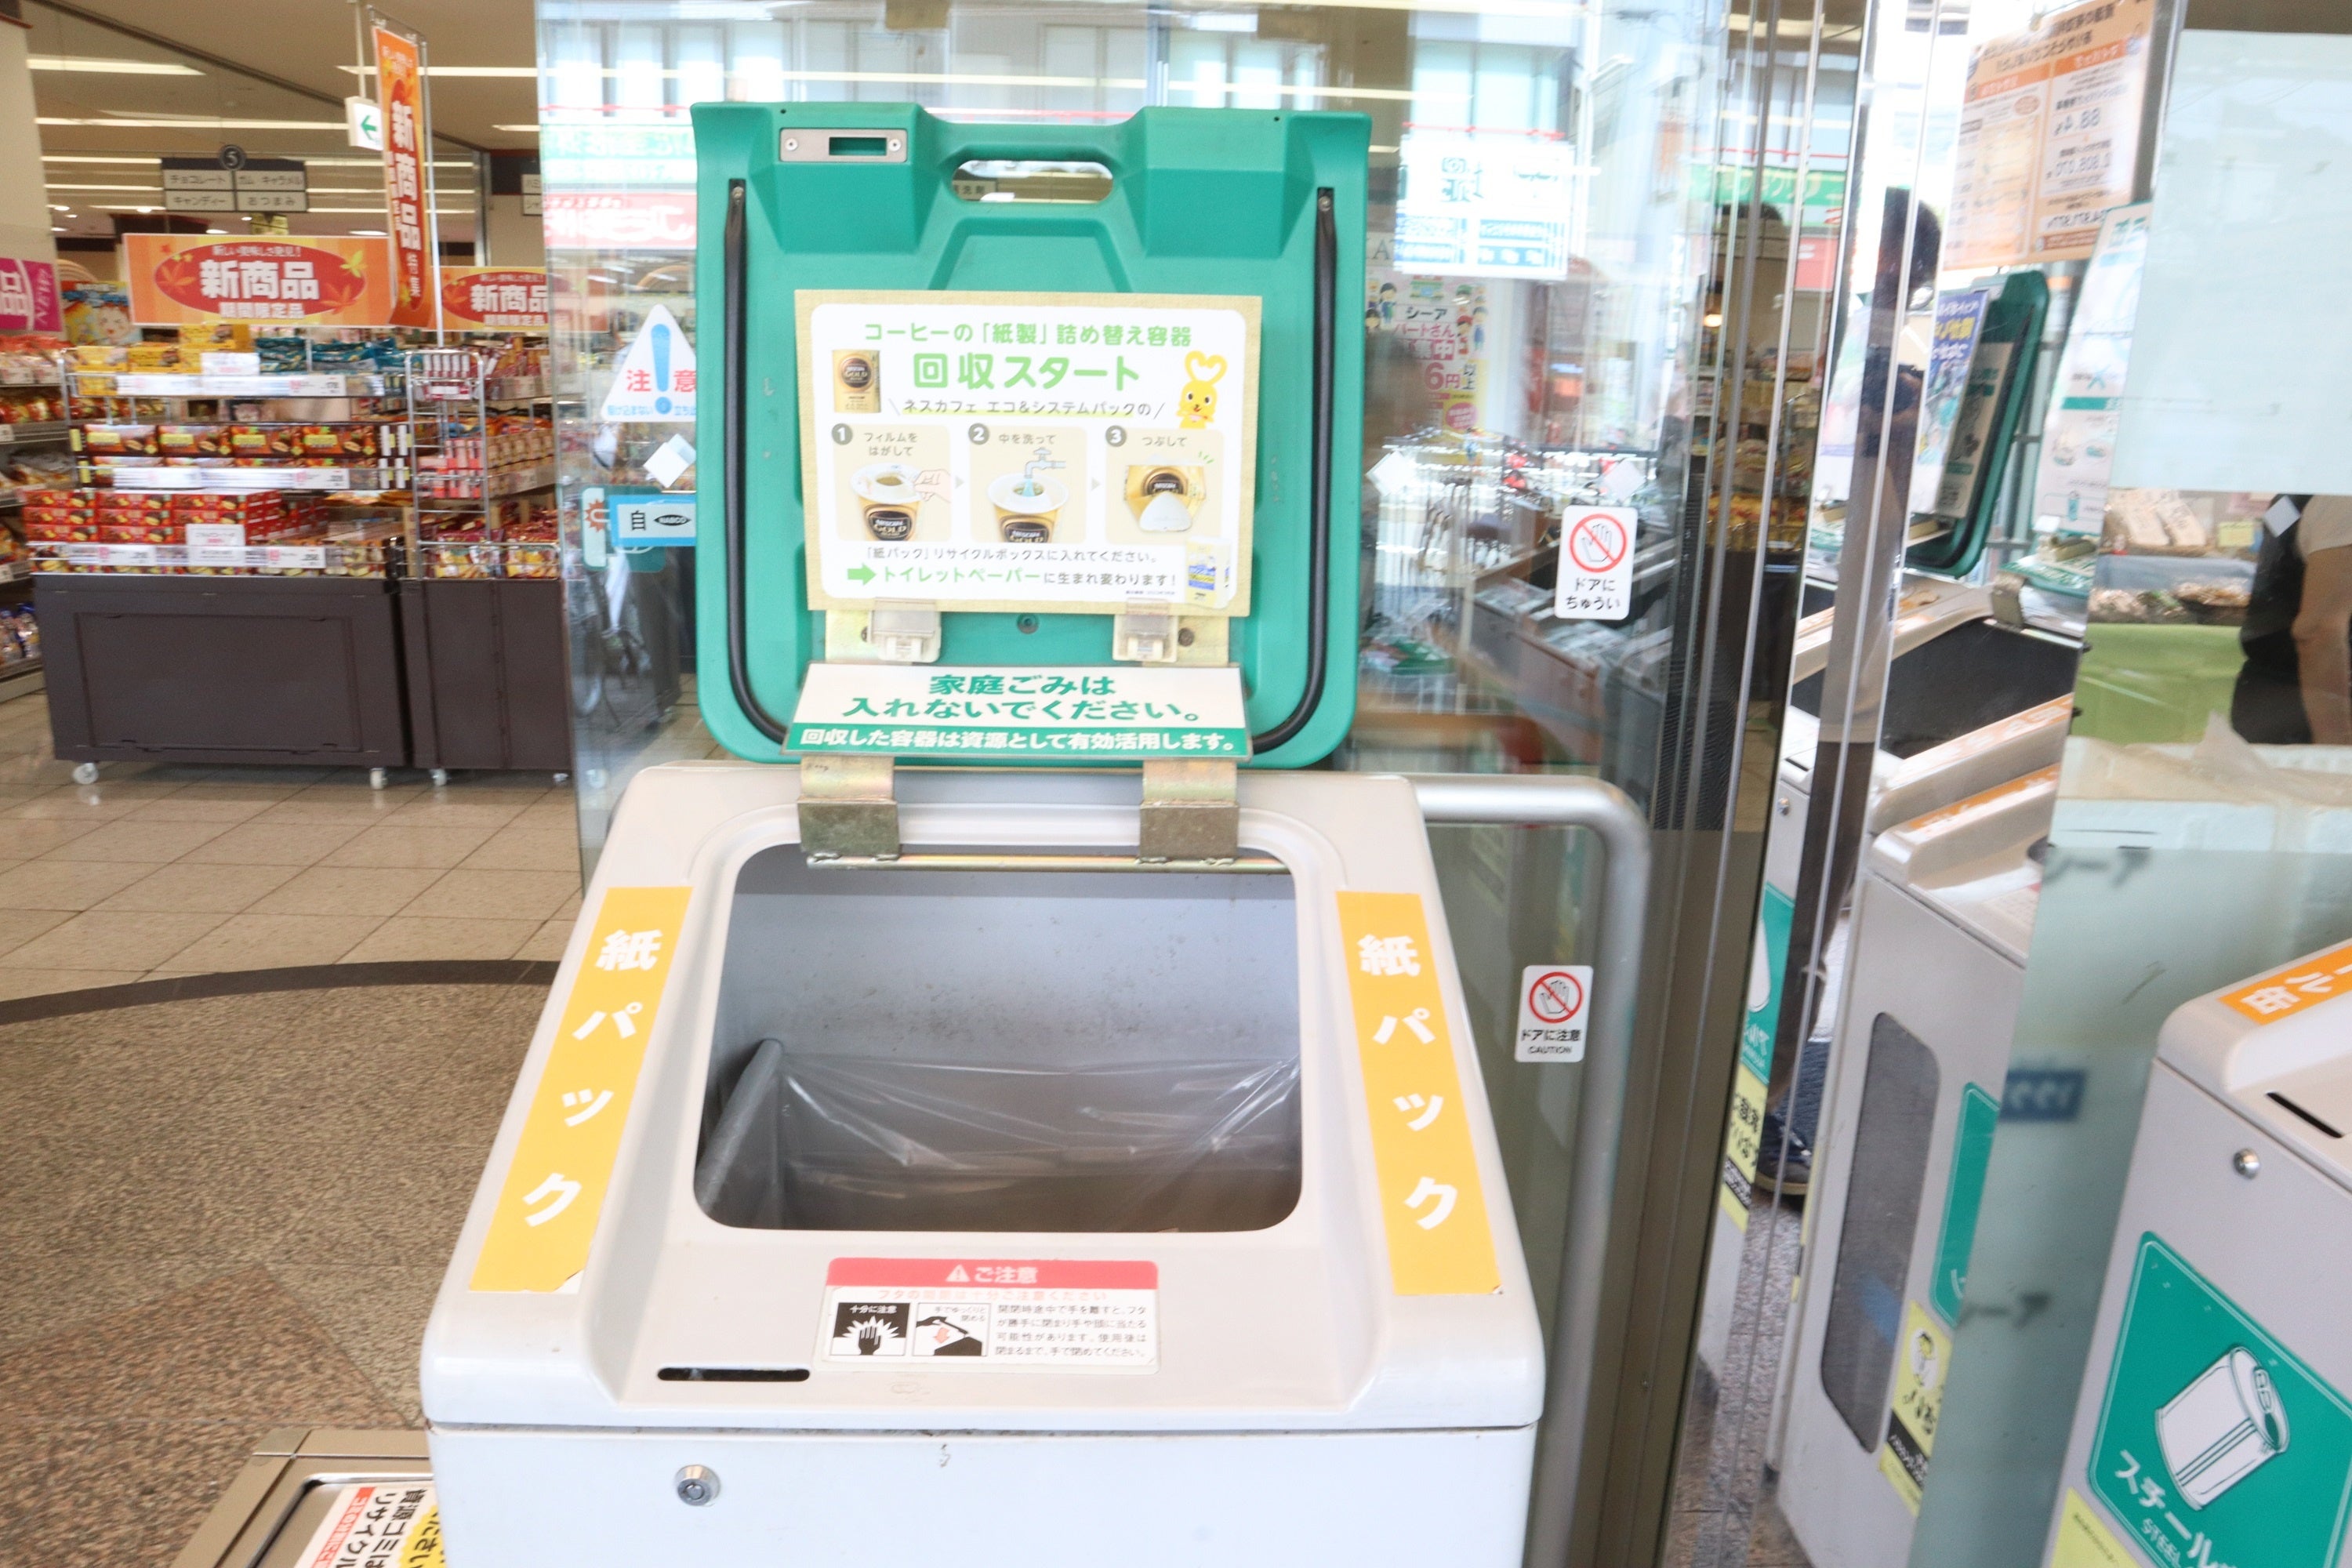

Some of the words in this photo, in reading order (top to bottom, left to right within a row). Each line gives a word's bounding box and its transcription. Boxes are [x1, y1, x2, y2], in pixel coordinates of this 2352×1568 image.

[170, 175, 225, 184] チョコレート
[392, 100, 421, 251] 新商品
[174, 197, 227, 205] キャンディー
[200, 260, 320, 299] 新商品
[866, 322, 1192, 347] コーヒーの「紙製」詰め替え容器
[913, 352, 1140, 390] 回収スタート
[902, 398, 978, 414] ネスカフェ
[863, 431, 918, 444] フィルムを
[999, 433, 1056, 445] 中を洗って
[1142, 436, 1188, 448] つぶして
[868, 445, 913, 457] はがして
[1575, 578, 1616, 592] ドアに
[1566, 596, 1620, 611] ちゅうい
[928, 673, 1116, 696] 家庭ごみは
[841, 696, 1200, 722] 入れないでください。
[799, 728, 1236, 752] 回収した容器は資源として有効活用します。
[1521, 1028, 1581, 1043] ドアに注意
[1527, 1044, 1573, 1054] CAUTION
[523, 930, 664, 1227] 紙パック
[1357, 934, 1457, 1230] 紙パック
[975, 1266, 1039, 1284] ご注意
[849, 1304, 898, 1314] 十分に注意
[2114, 1449, 2238, 1568] スチール
